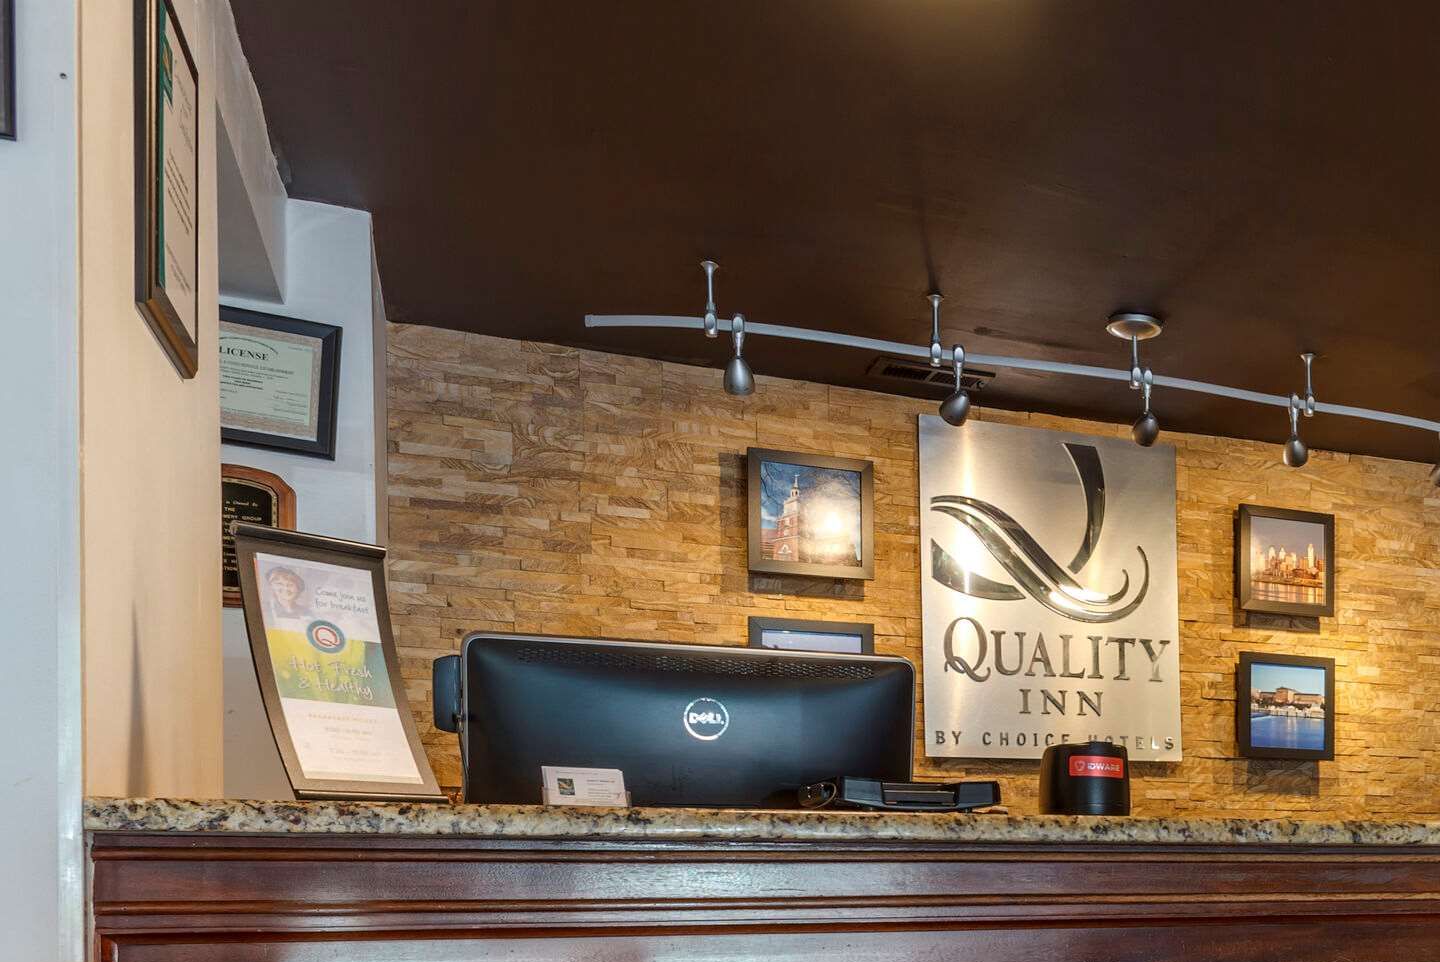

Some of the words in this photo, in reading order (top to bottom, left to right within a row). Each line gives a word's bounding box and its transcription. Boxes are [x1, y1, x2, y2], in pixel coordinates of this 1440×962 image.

[219, 346, 269, 361] LICENSE
[943, 616, 1171, 683] QUALITY
[327, 661, 373, 679] Fresh
[316, 677, 374, 700] Healthy
[1019, 688, 1104, 717] INN
[689, 712, 724, 725] DELL
[935, 730, 962, 745] BY
[982, 732, 1071, 747] CHOICE
